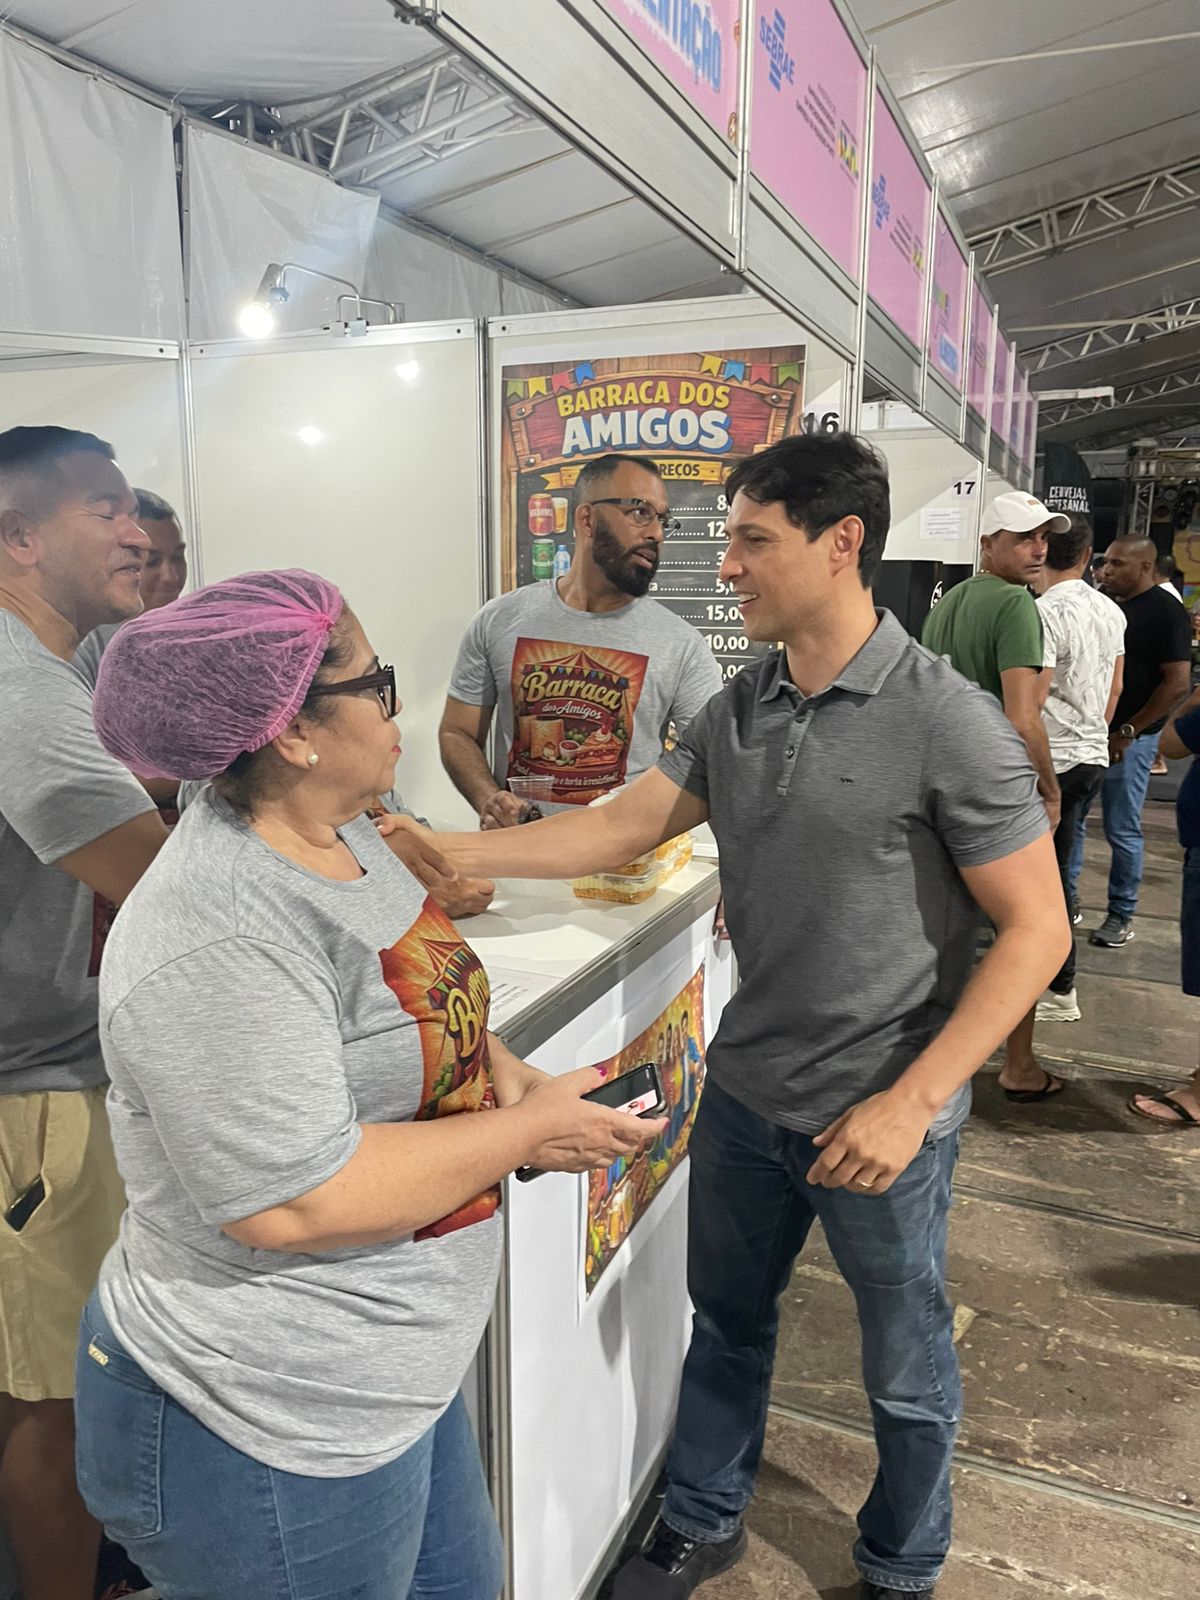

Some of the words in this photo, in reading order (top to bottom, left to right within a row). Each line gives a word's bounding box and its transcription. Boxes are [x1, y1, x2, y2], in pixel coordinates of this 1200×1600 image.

[645, 0, 722, 93] NTAÇÃO
[760, 15, 795, 86] SEBRAE
[557, 380, 671, 417] BARRACA
[678, 382, 731, 409] DOS
[560, 407, 732, 456] AMIGOS
[803, 412, 840, 435] 16
[658, 463, 700, 478] REÇOS
[953, 481, 976, 495] 17
[1049, 486, 1087, 500] CERVEJAS
[706, 605, 744, 623] 15,0
[705, 634, 749, 653] 10,00
[523, 671, 621, 710] Barraca
[556, 701, 602, 719] Amigos
